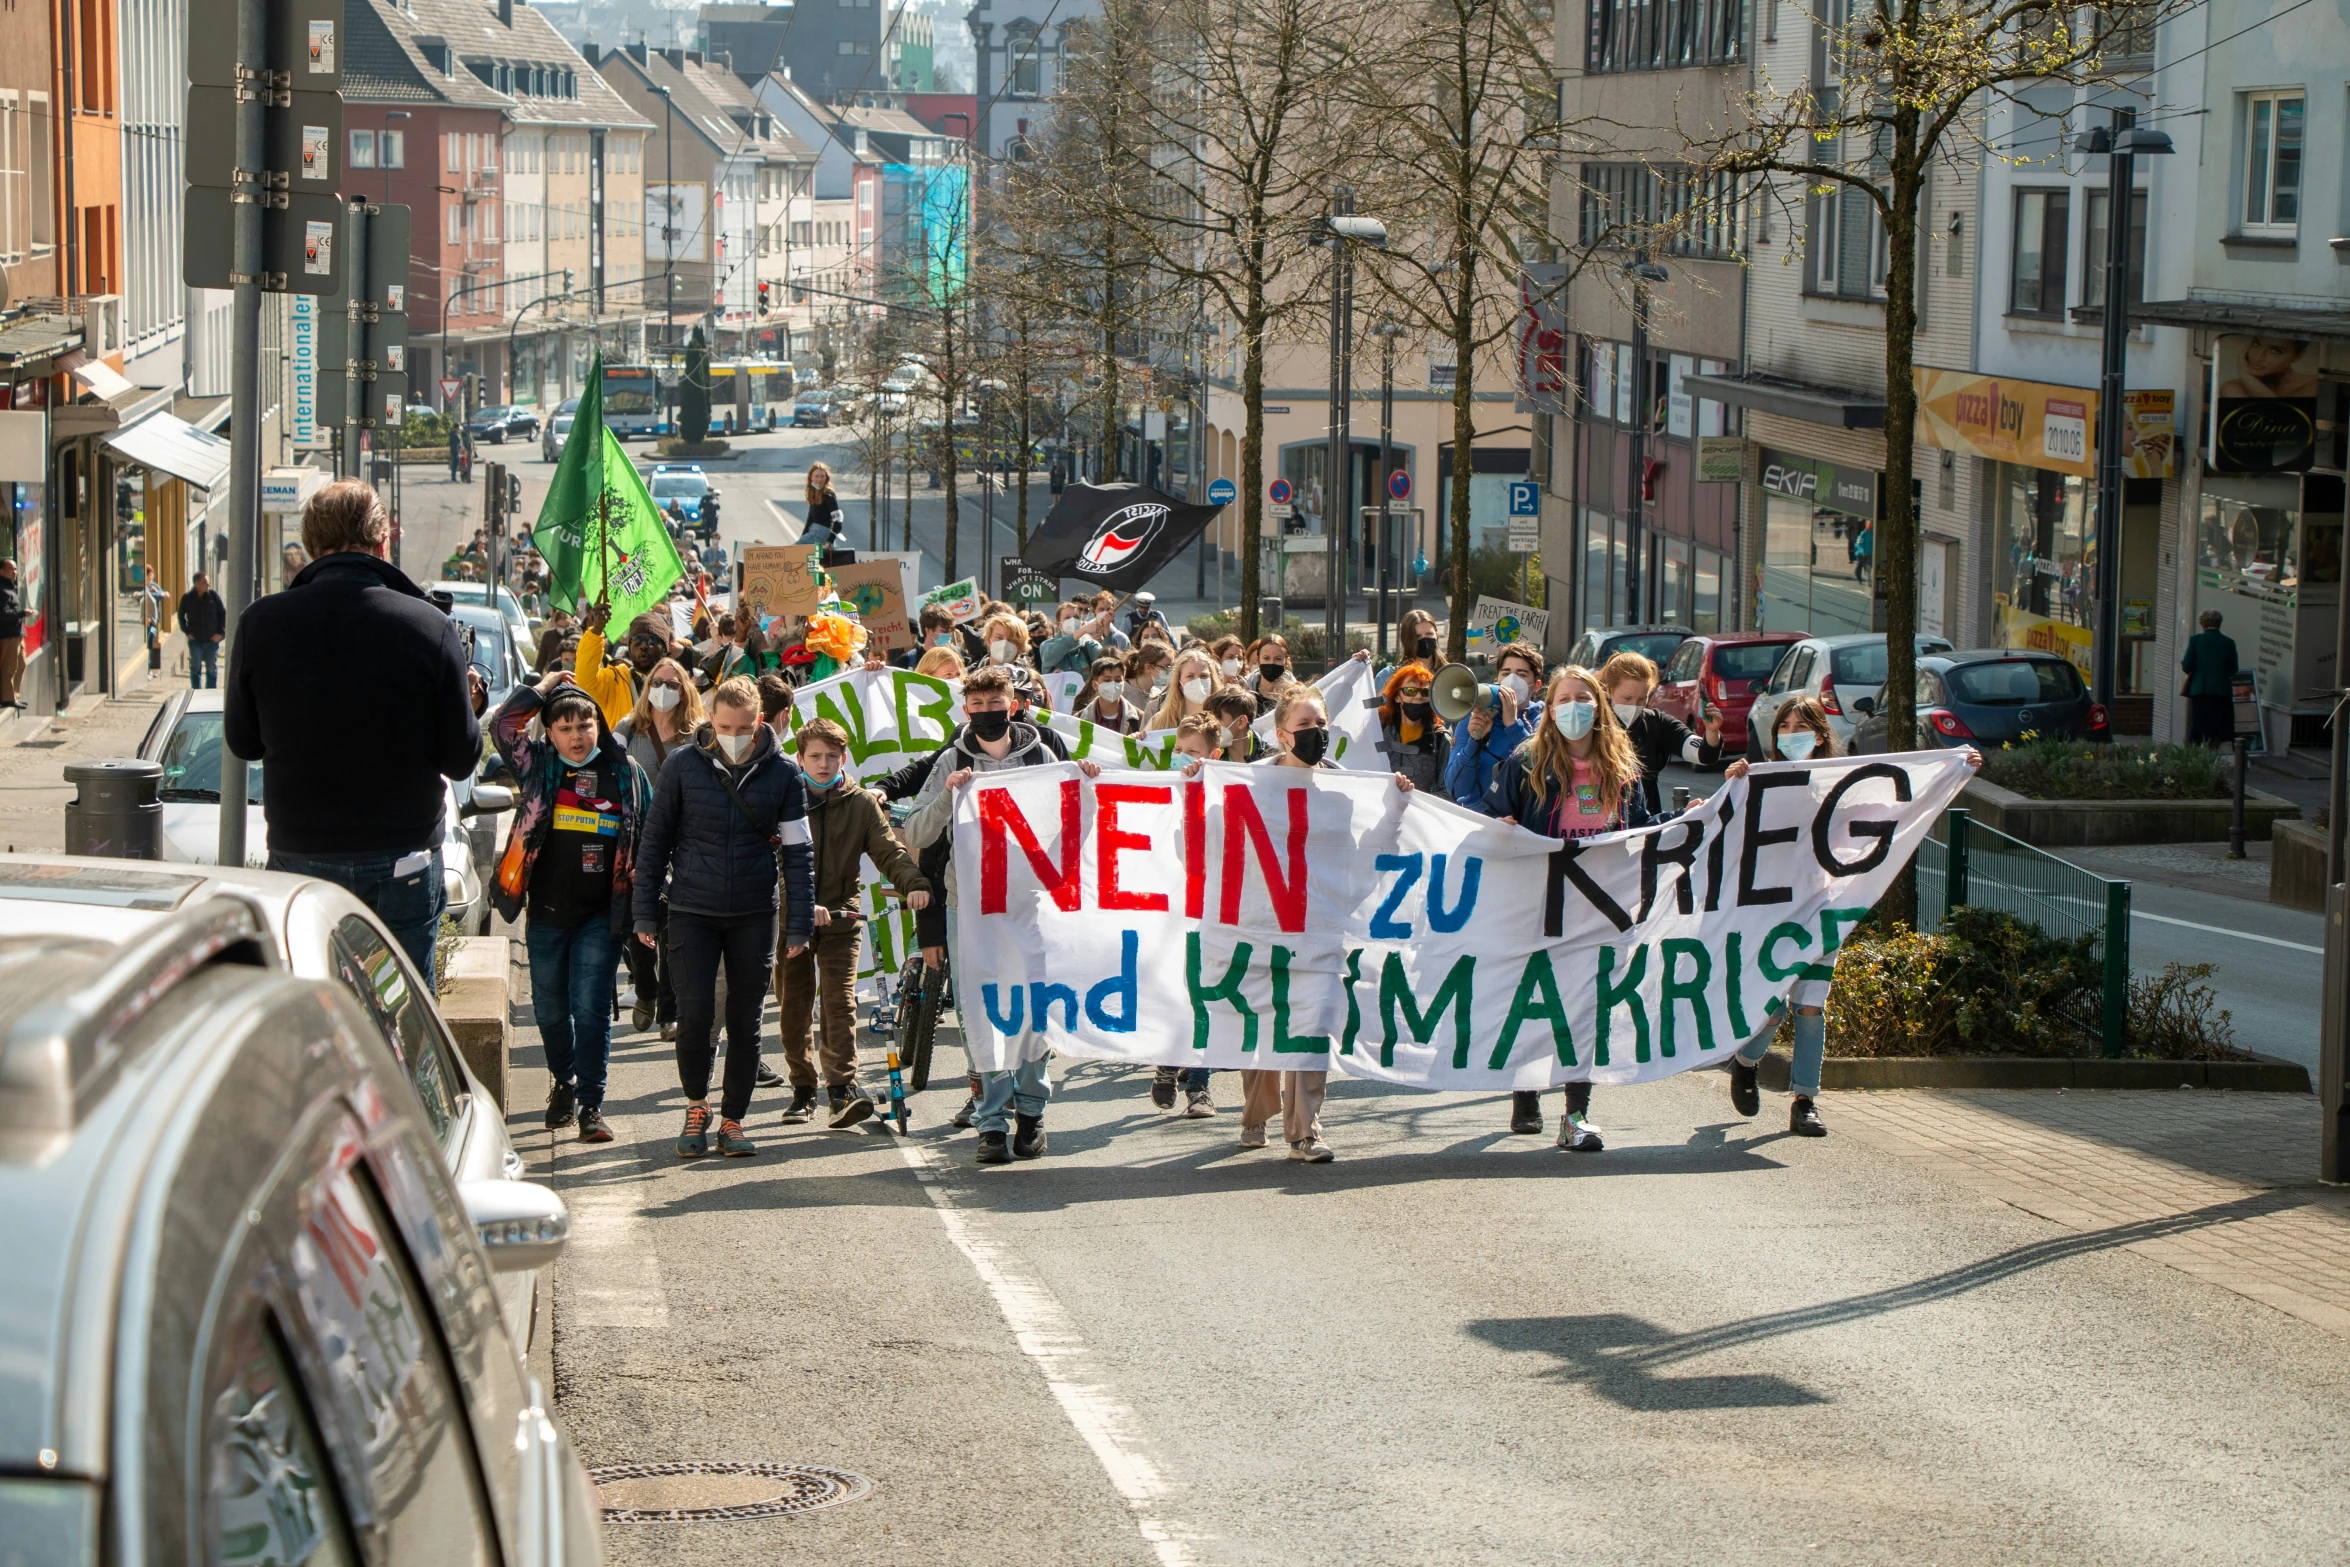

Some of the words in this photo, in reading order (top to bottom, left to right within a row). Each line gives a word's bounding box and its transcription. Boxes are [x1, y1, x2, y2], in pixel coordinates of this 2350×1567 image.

[293, 295, 312, 443] Internationaler
[2152, 395, 2171, 404] boy
[1956, 392, 1988, 430] pizza
[2000, 393, 2024, 440] boy
[1701, 446, 1741, 454] EKIP
[261, 486, 296, 494] EEMAN
[1762, 464, 1819, 497] EKIP
[1514, 486, 1530, 511] P
[755, 551, 773, 560] AFRAID
[748, 562, 761, 571] HAVE
[762, 562, 782, 570] HUMANS
[1005, 575, 1027, 591] WHAT
[1034, 575, 1057, 592] STAND
[1020, 584, 1042, 598] ON
[1478, 603, 1504, 620] TREAT
[1505, 606, 1519, 617] THE
[1520, 610, 1547, 634] EARTH
[1485, 624, 1496, 645] WITH
[2026, 627, 2047, 649] pizza
[2055, 633, 2070, 657] boy
[557, 814, 575, 822] STOP
[575, 815, 596, 825] PUTIN
[599, 818, 616, 829] STOP
[979, 778, 1308, 934] NEIN
[1369, 852, 1482, 940] ZU
[1543, 763, 1913, 938] KRIEG
[982, 929, 1138, 1037] und
[1185, 907, 1869, 1072] KLIMAKRISE
